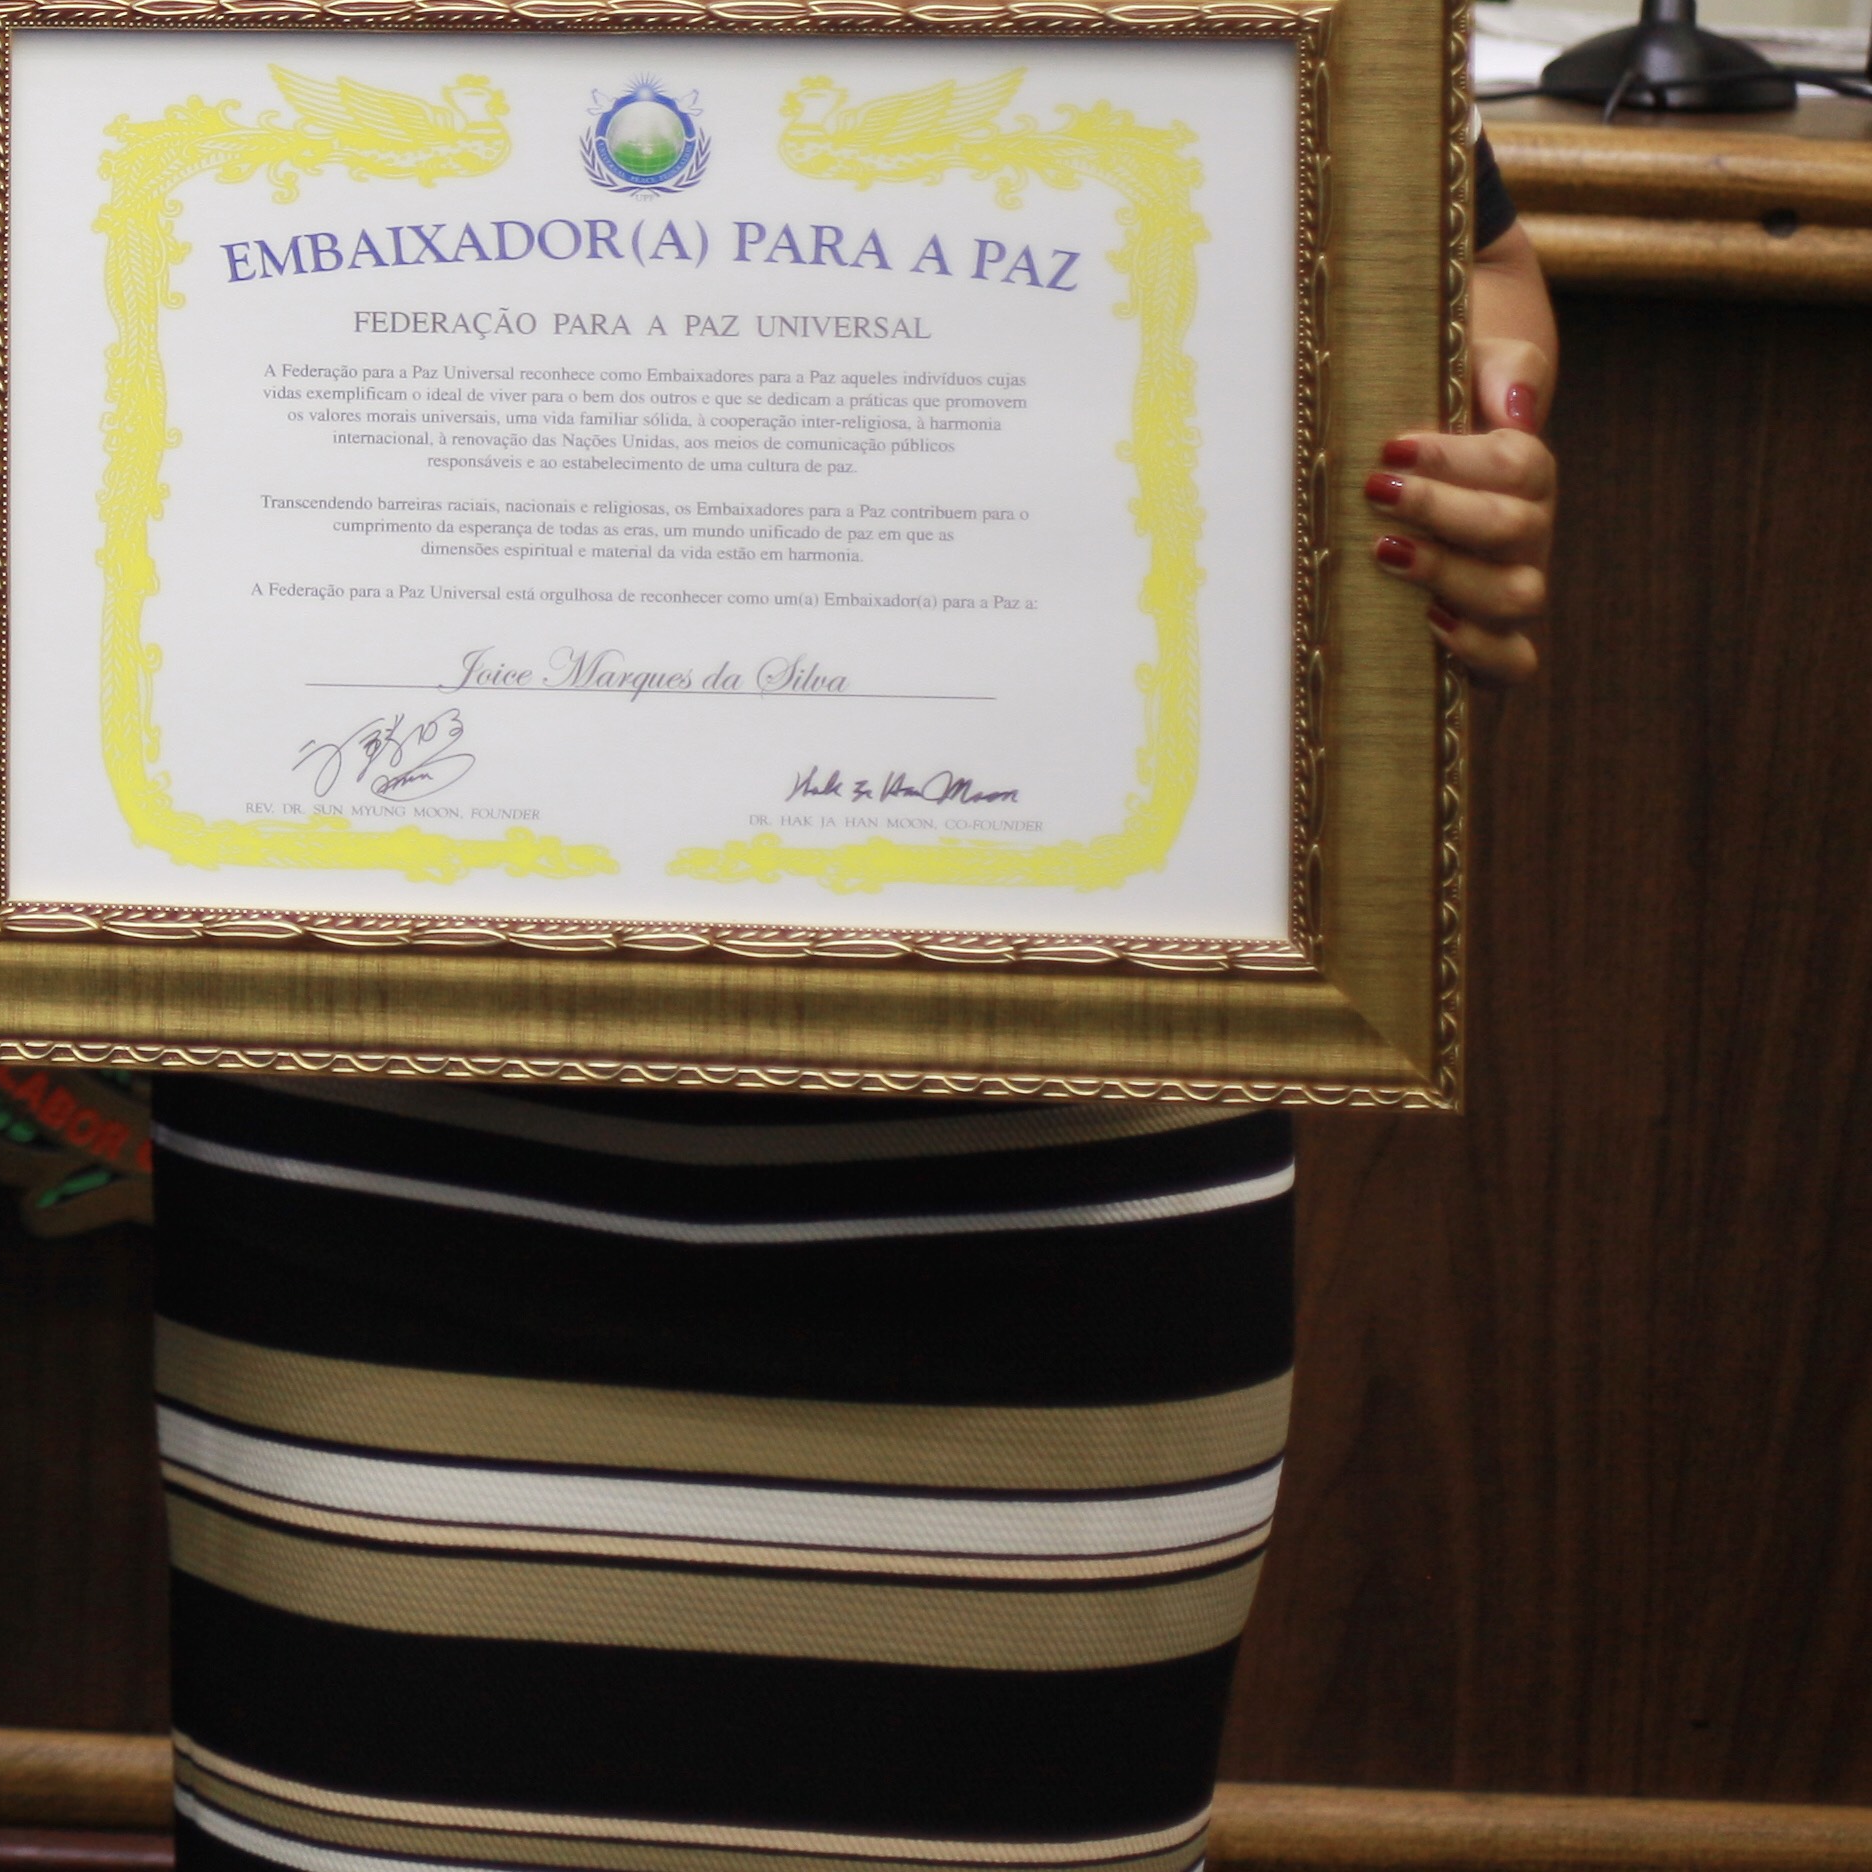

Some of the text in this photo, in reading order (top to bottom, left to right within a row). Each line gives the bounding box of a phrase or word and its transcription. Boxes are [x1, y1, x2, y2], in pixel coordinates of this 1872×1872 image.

[220, 217, 1081, 292] EMBAIXADOR(A) PARA A PAZ
[353, 306, 931, 340] FEDERAÇÃO PARA A PAZ UNIVERSAL
[332, 429, 955, 455] internacional, à renovação das Nações Unidas, aos meios de comunicação públicos
[420, 540, 863, 562] dimensões espiritual e material da vida estão em harmonia.
[438, 646, 846, 703] Joice Marques da Silva
[246, 803, 540, 820] REV. DR. SUN MYUNG MOON, FOUNDER
[749, 815, 1043, 831] DR. HAK JA HAN MOON, CO-FOUNDER
